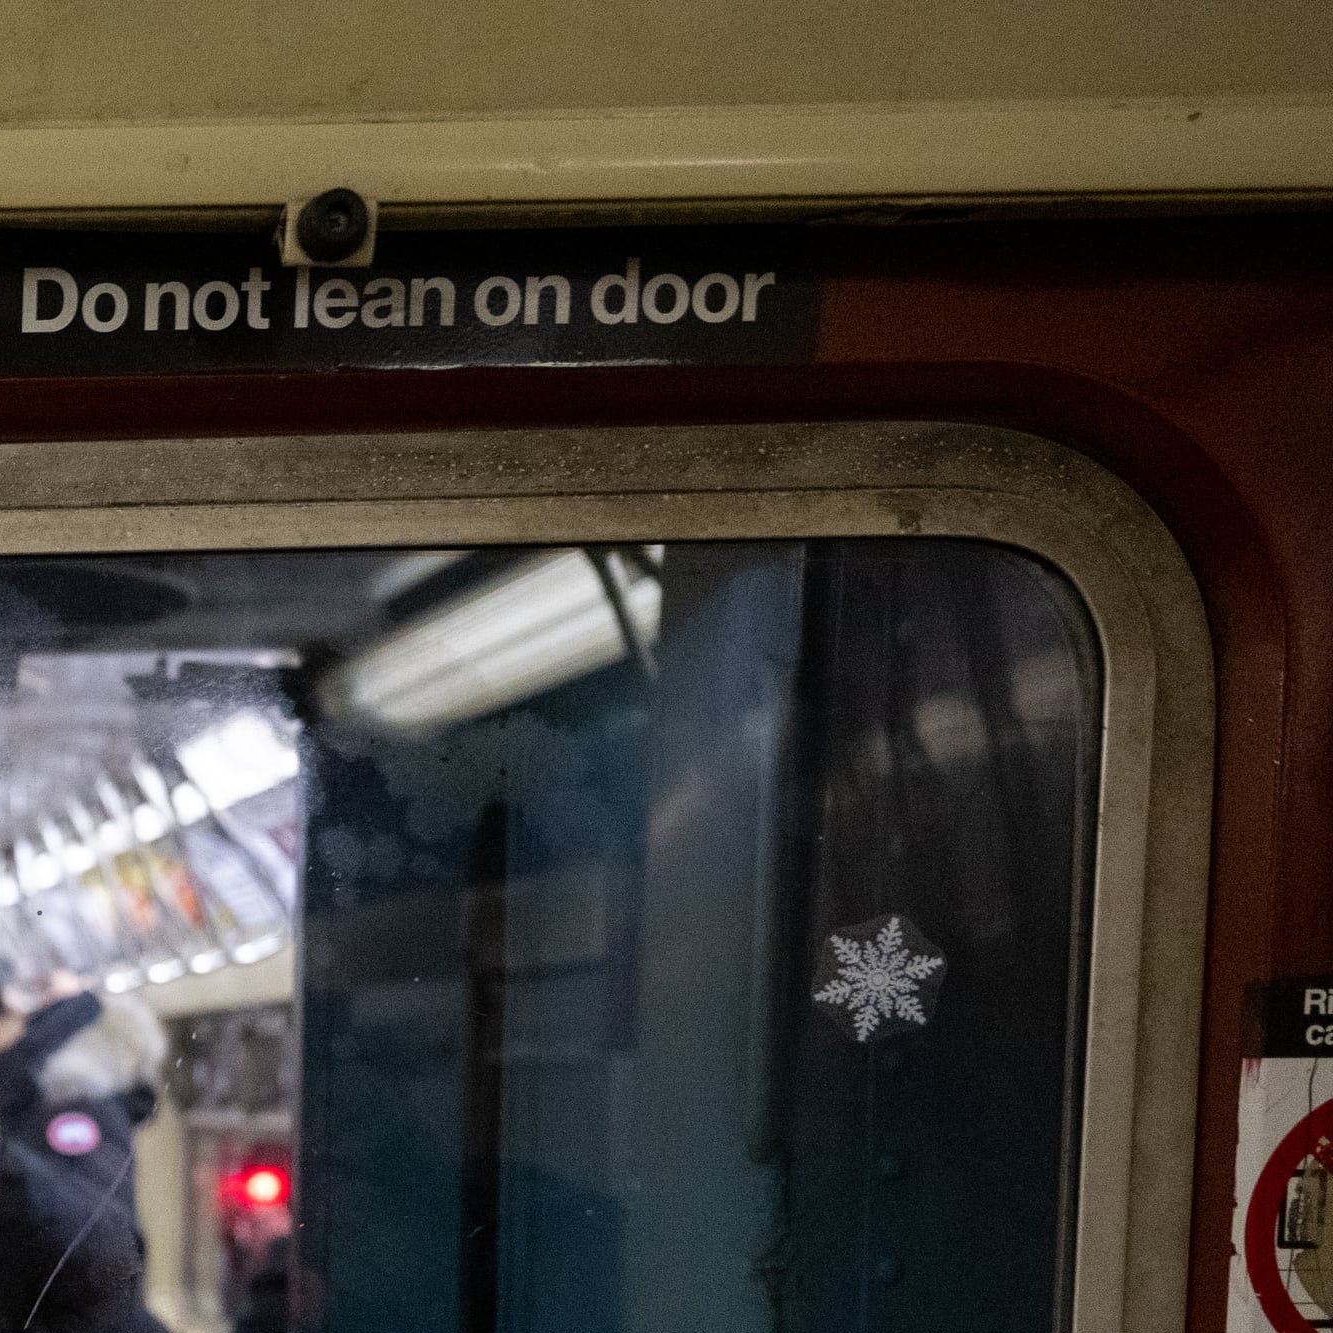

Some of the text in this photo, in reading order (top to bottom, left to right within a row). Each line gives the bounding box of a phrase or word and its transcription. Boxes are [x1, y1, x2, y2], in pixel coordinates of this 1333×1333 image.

[20, 257, 776, 334] Do not lean on door
